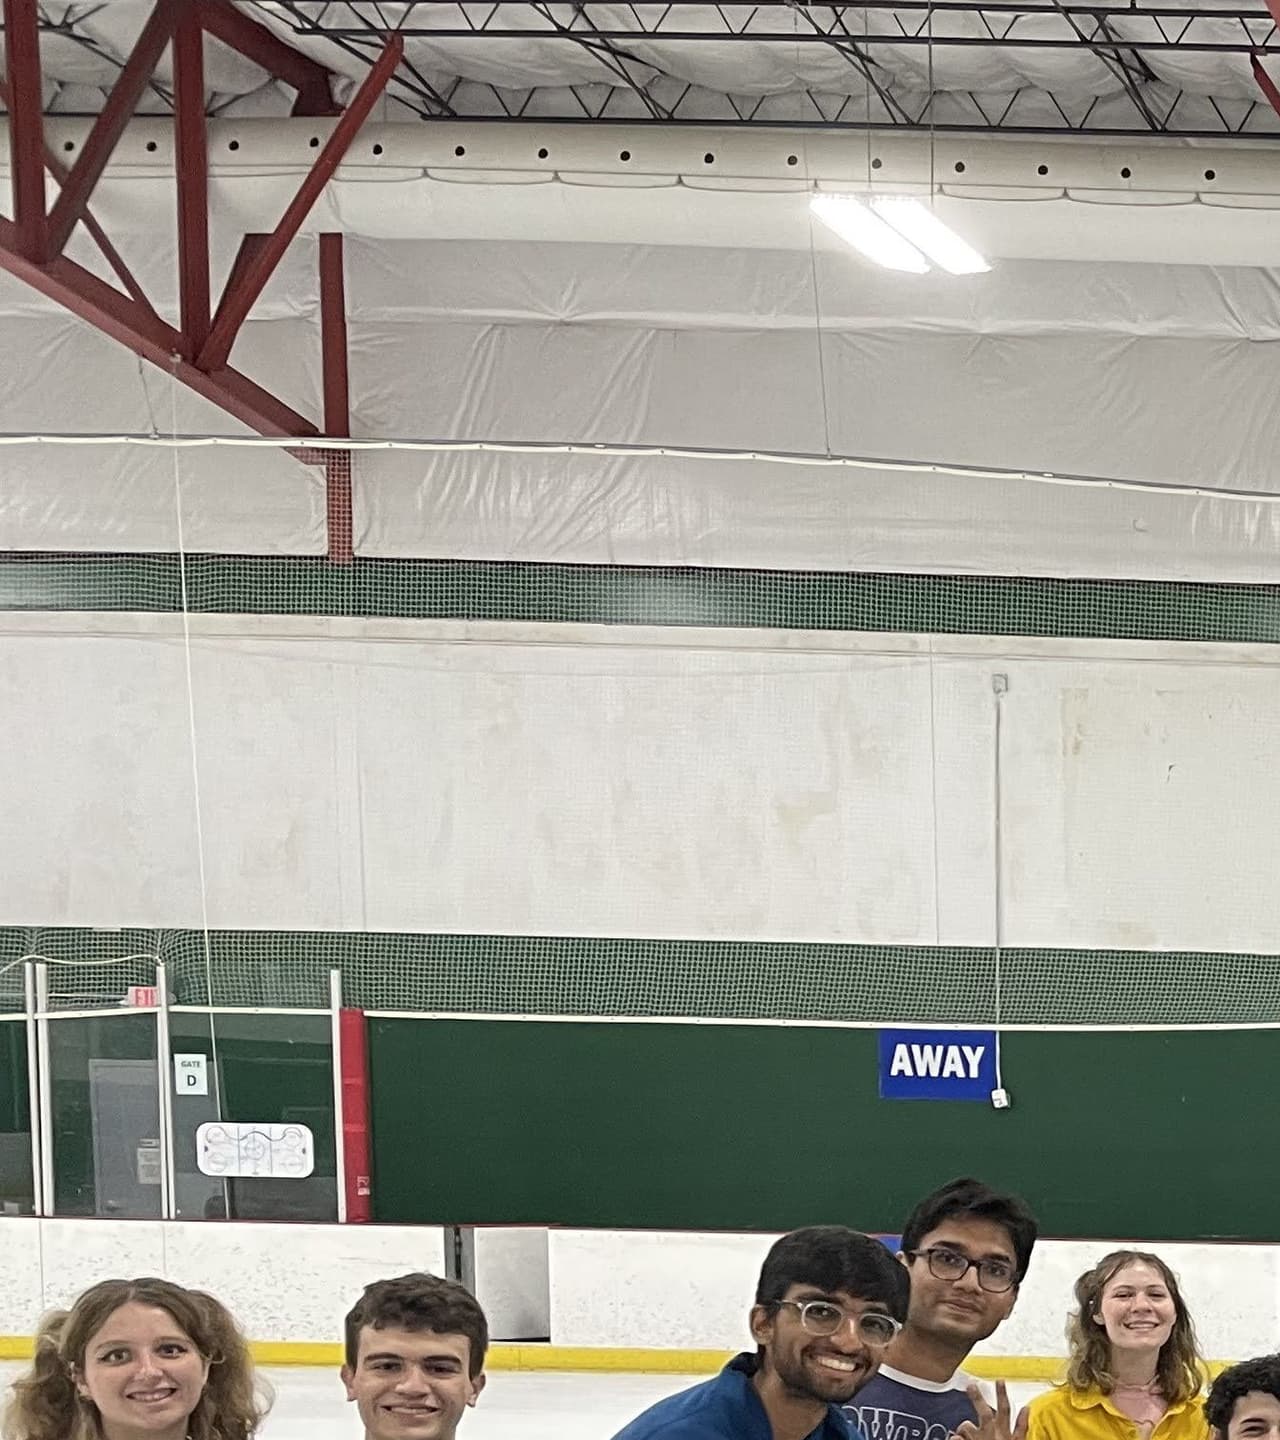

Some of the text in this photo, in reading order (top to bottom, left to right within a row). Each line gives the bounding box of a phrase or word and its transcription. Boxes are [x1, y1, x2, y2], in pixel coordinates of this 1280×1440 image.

[180, 1060, 202, 1069] GATE
[890, 1043, 985, 1079] AWAY
[186, 1074, 197, 1087] D
